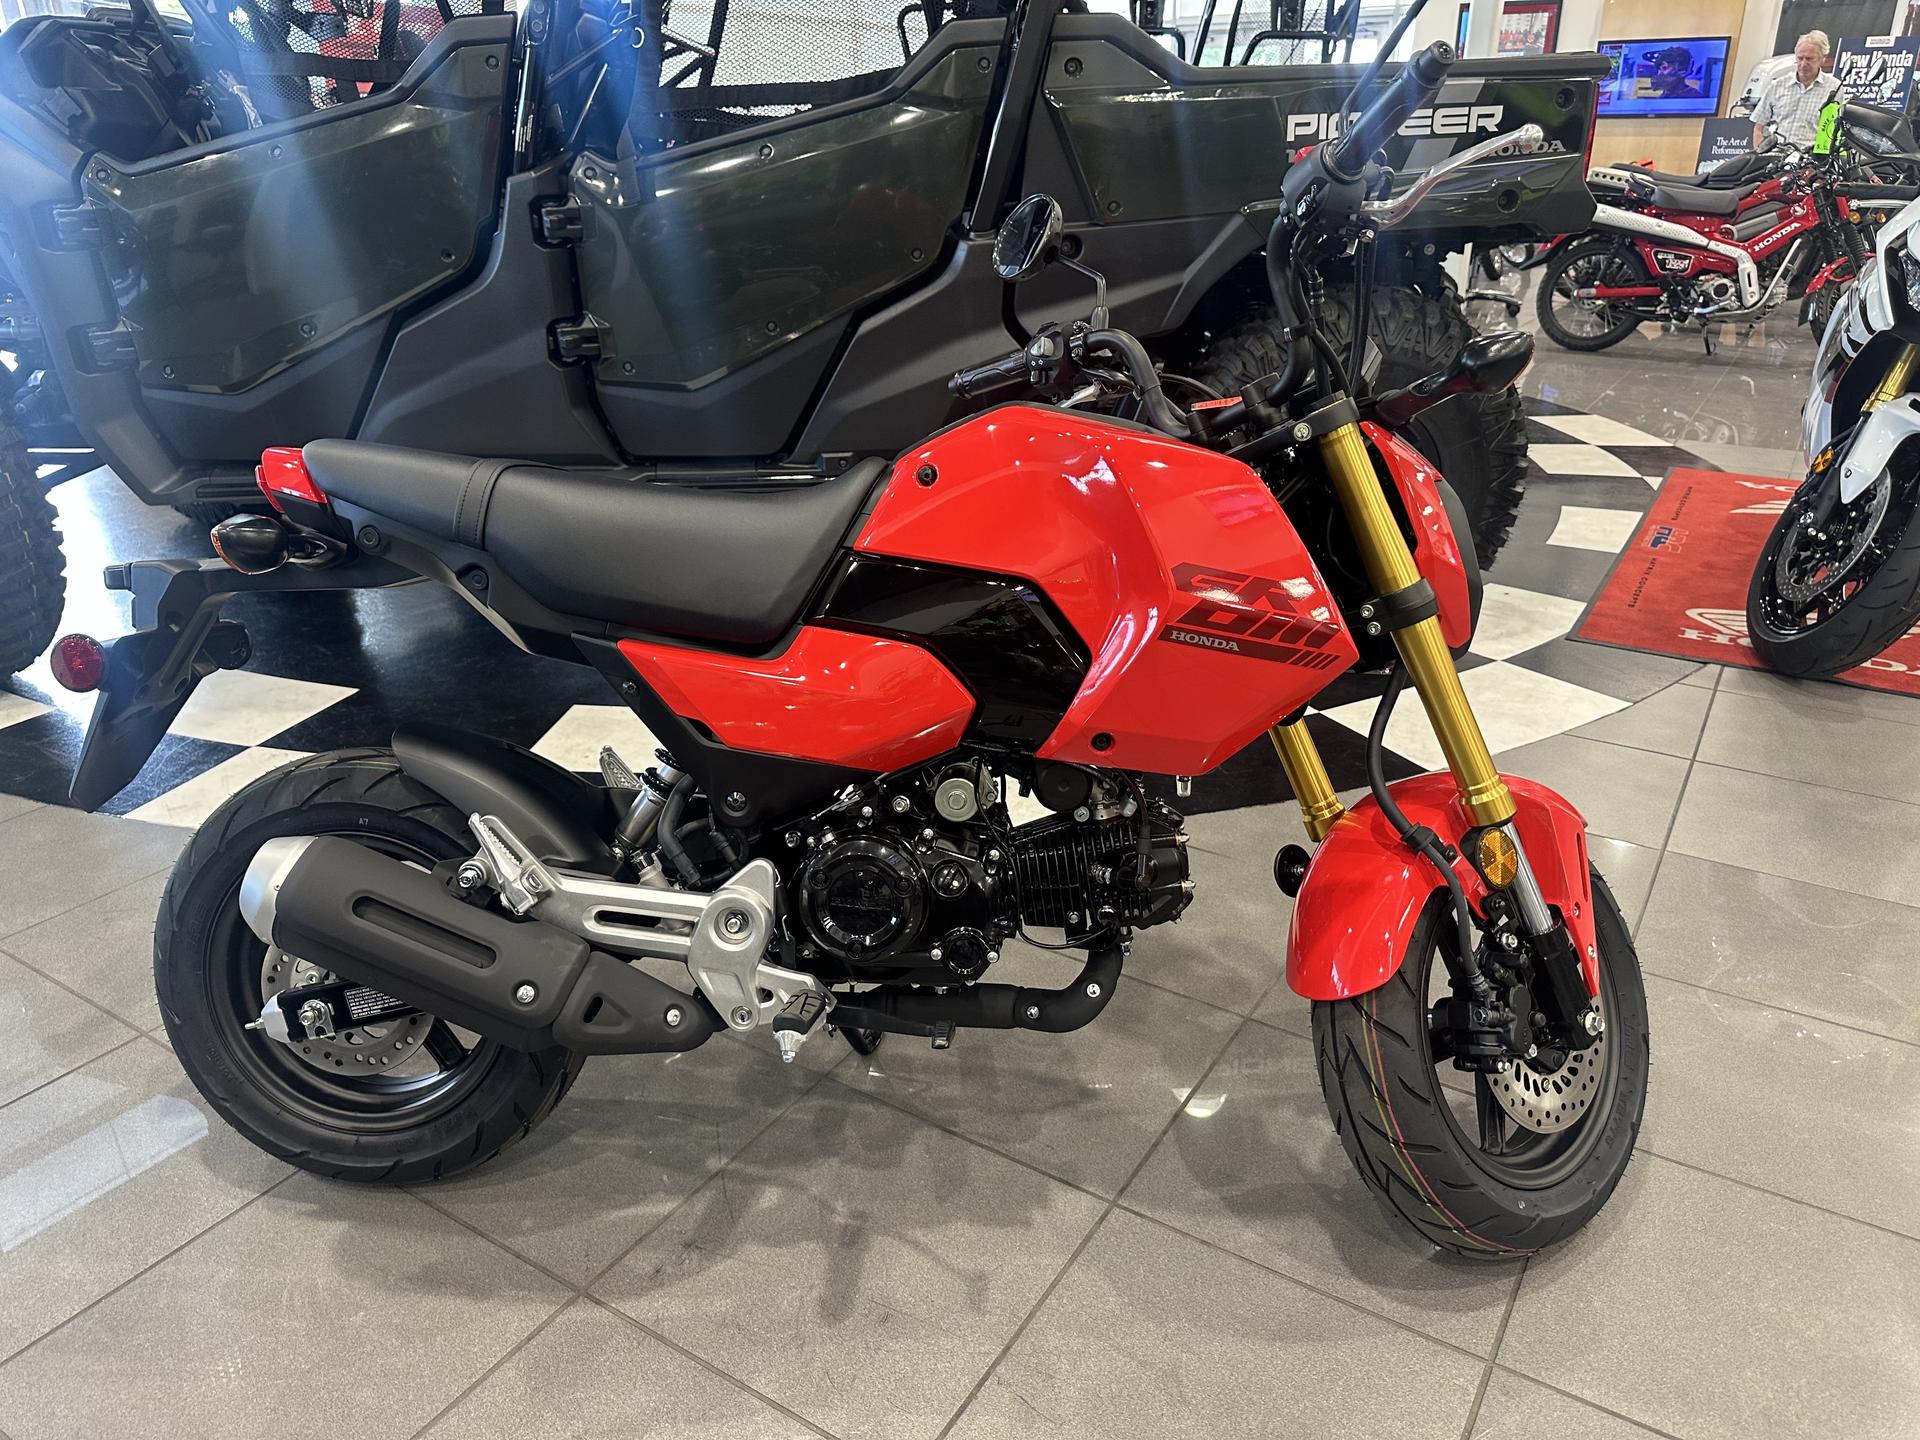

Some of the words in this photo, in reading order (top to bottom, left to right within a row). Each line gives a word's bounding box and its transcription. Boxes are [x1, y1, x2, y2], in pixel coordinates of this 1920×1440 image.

[1716, 136, 1728, 146] The
[1728, 136, 1740, 146] Art
[1740, 136, 1749, 146] of
[1753, 221, 1802, 252] HONDA
[1170, 630, 1240, 652] HONDA
